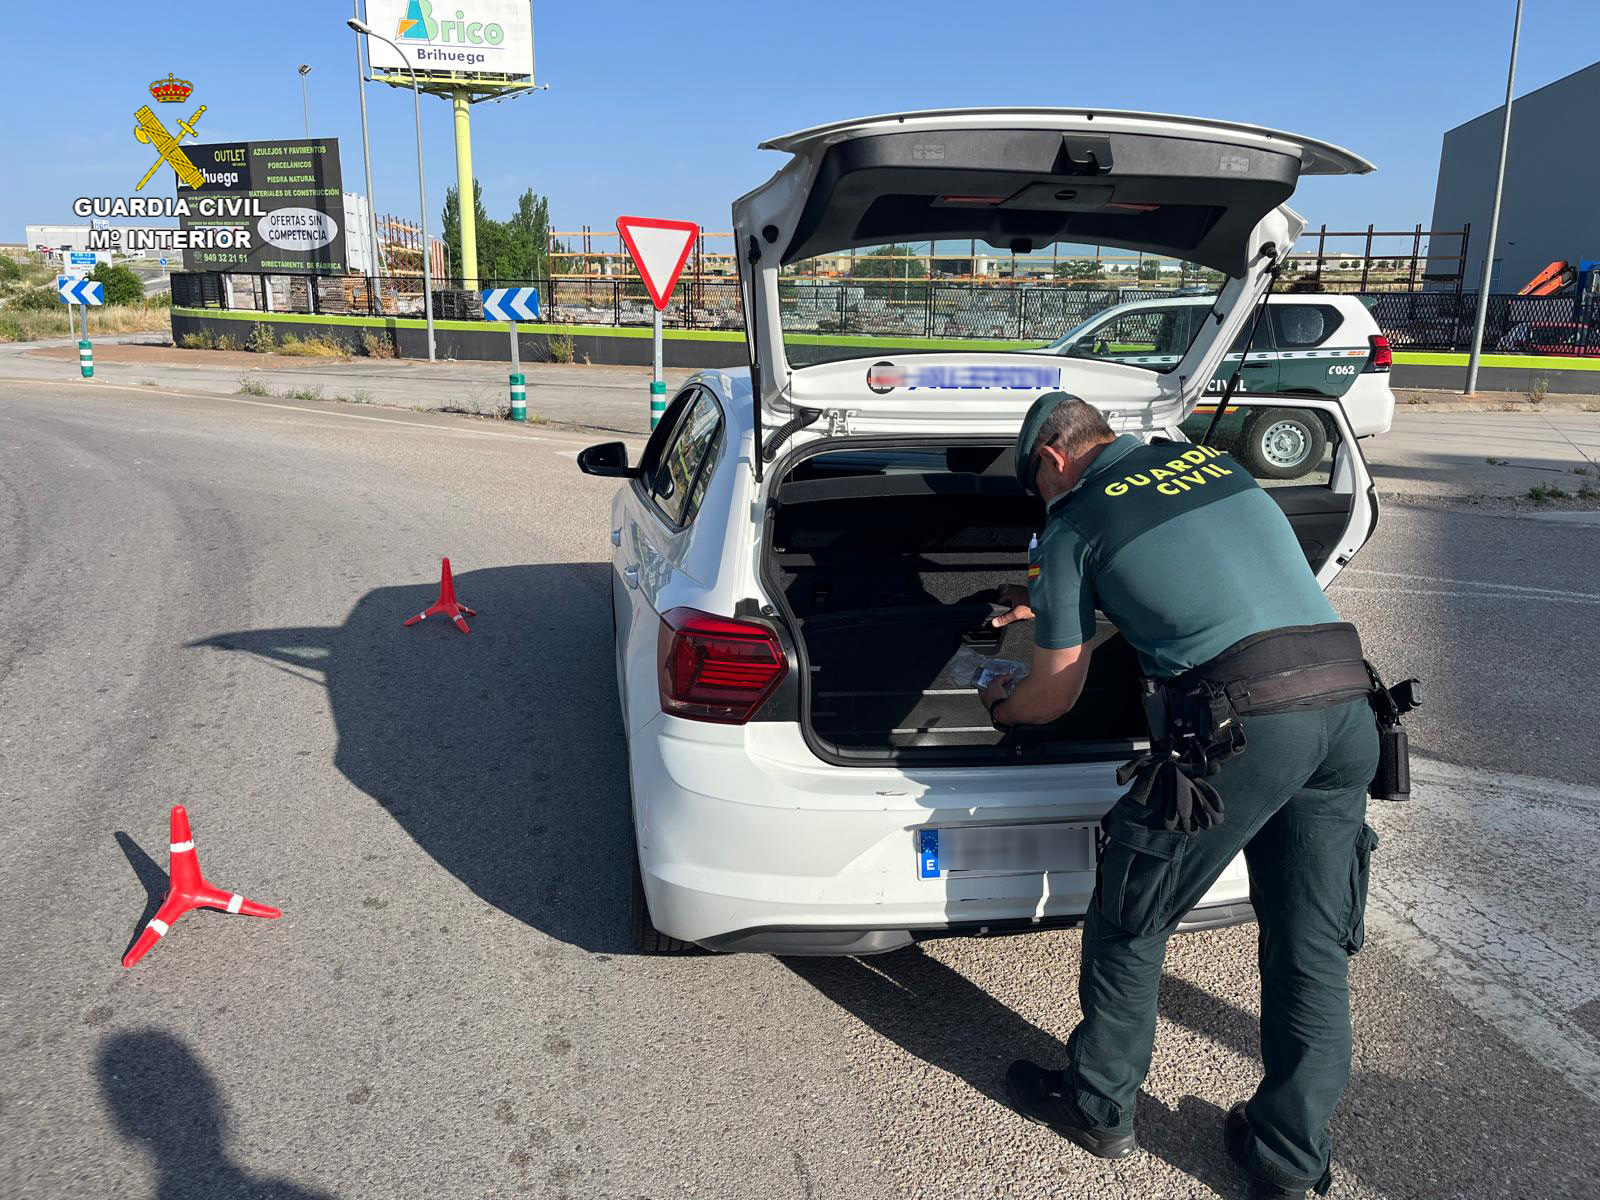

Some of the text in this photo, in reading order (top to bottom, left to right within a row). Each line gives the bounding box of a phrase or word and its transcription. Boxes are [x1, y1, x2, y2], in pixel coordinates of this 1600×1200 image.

[417, 48, 485, 65] Brihuega
[214, 149, 245, 162] OUTLET
[253, 147, 283, 155] AZULEJOS
[289, 146, 327, 154] PAVIMENTOS
[288, 175, 316, 183] NATURAL
[284, 189, 293, 197] DE
[293, 188, 340, 196] CONSTRUCCIÓN
[270, 215, 322, 226] OFERTAS SIN
[268, 229, 328, 241] COMPETENCIA
[204, 253, 248, 263] 949 32 21 51
[261, 260, 304, 269] DIRECTAMENTE
[306, 261, 315, 269] DE
[1335, 365, 1355, 375] 062
[1156, 463, 1233, 496] CIVIL
[926, 859, 935, 871] E
